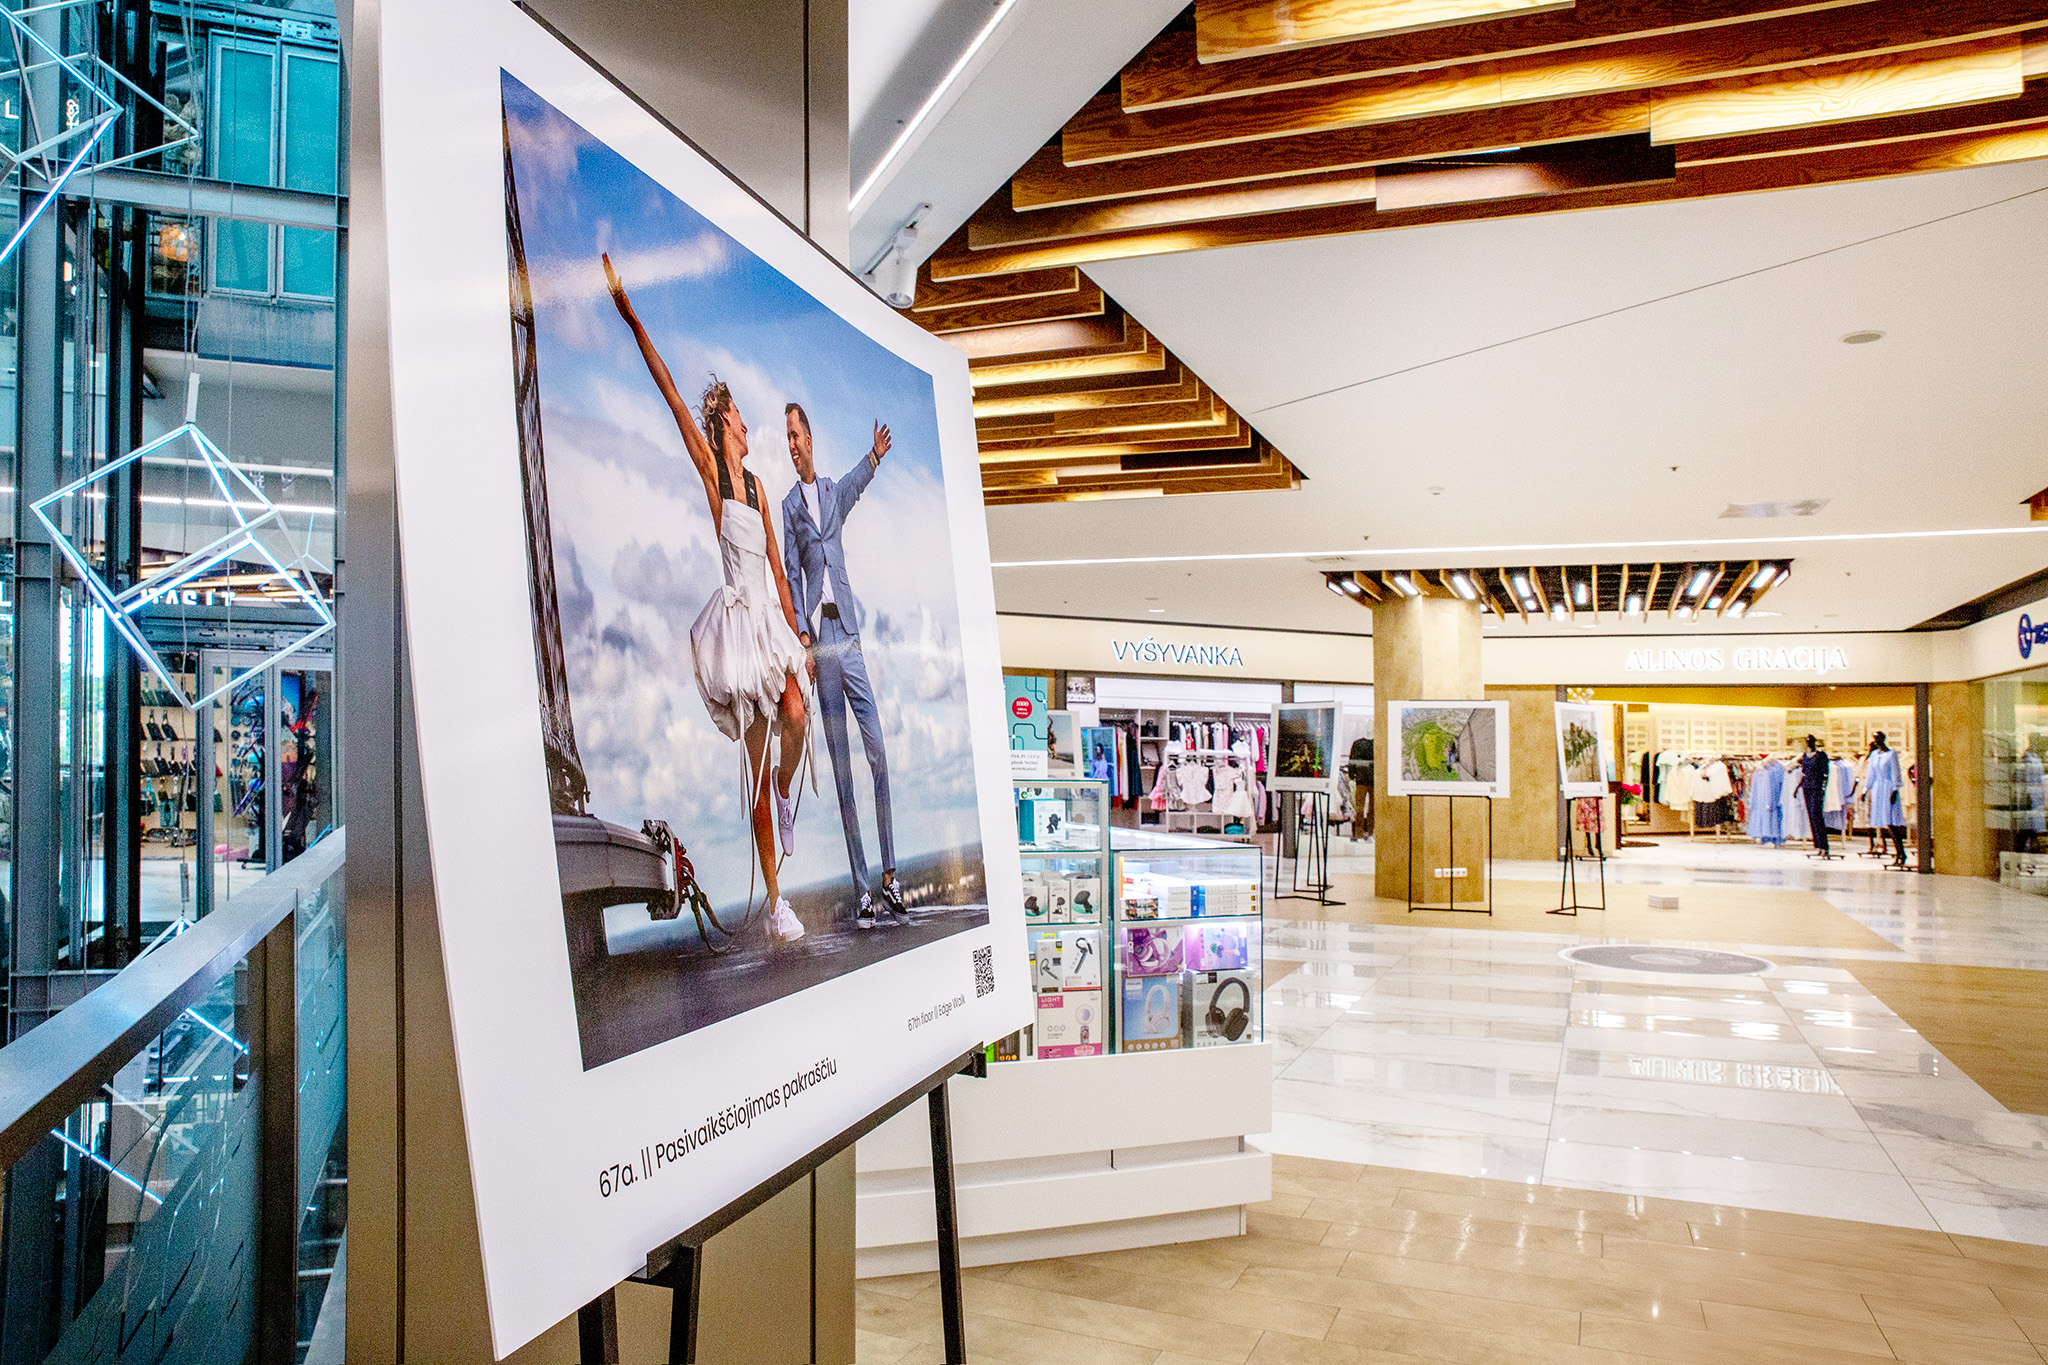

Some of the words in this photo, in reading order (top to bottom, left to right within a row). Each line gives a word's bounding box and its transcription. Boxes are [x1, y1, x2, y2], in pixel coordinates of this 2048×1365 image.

[1110, 636, 1244, 667] VYŠYVANKA
[1626, 648, 1723, 671] ALINOS
[1734, 647, 1849, 675] GRACIJA
[907, 1016, 921, 1031] 67th
[921, 1012, 934, 1025] floor
[938, 1002, 952, 1017] Edge
[952, 993, 966, 1009] Walk
[599, 1163, 639, 1198] 67a.
[655, 1088, 781, 1169] Pasivaikščiojimas
[782, 1057, 838, 1108] pakraščiu
